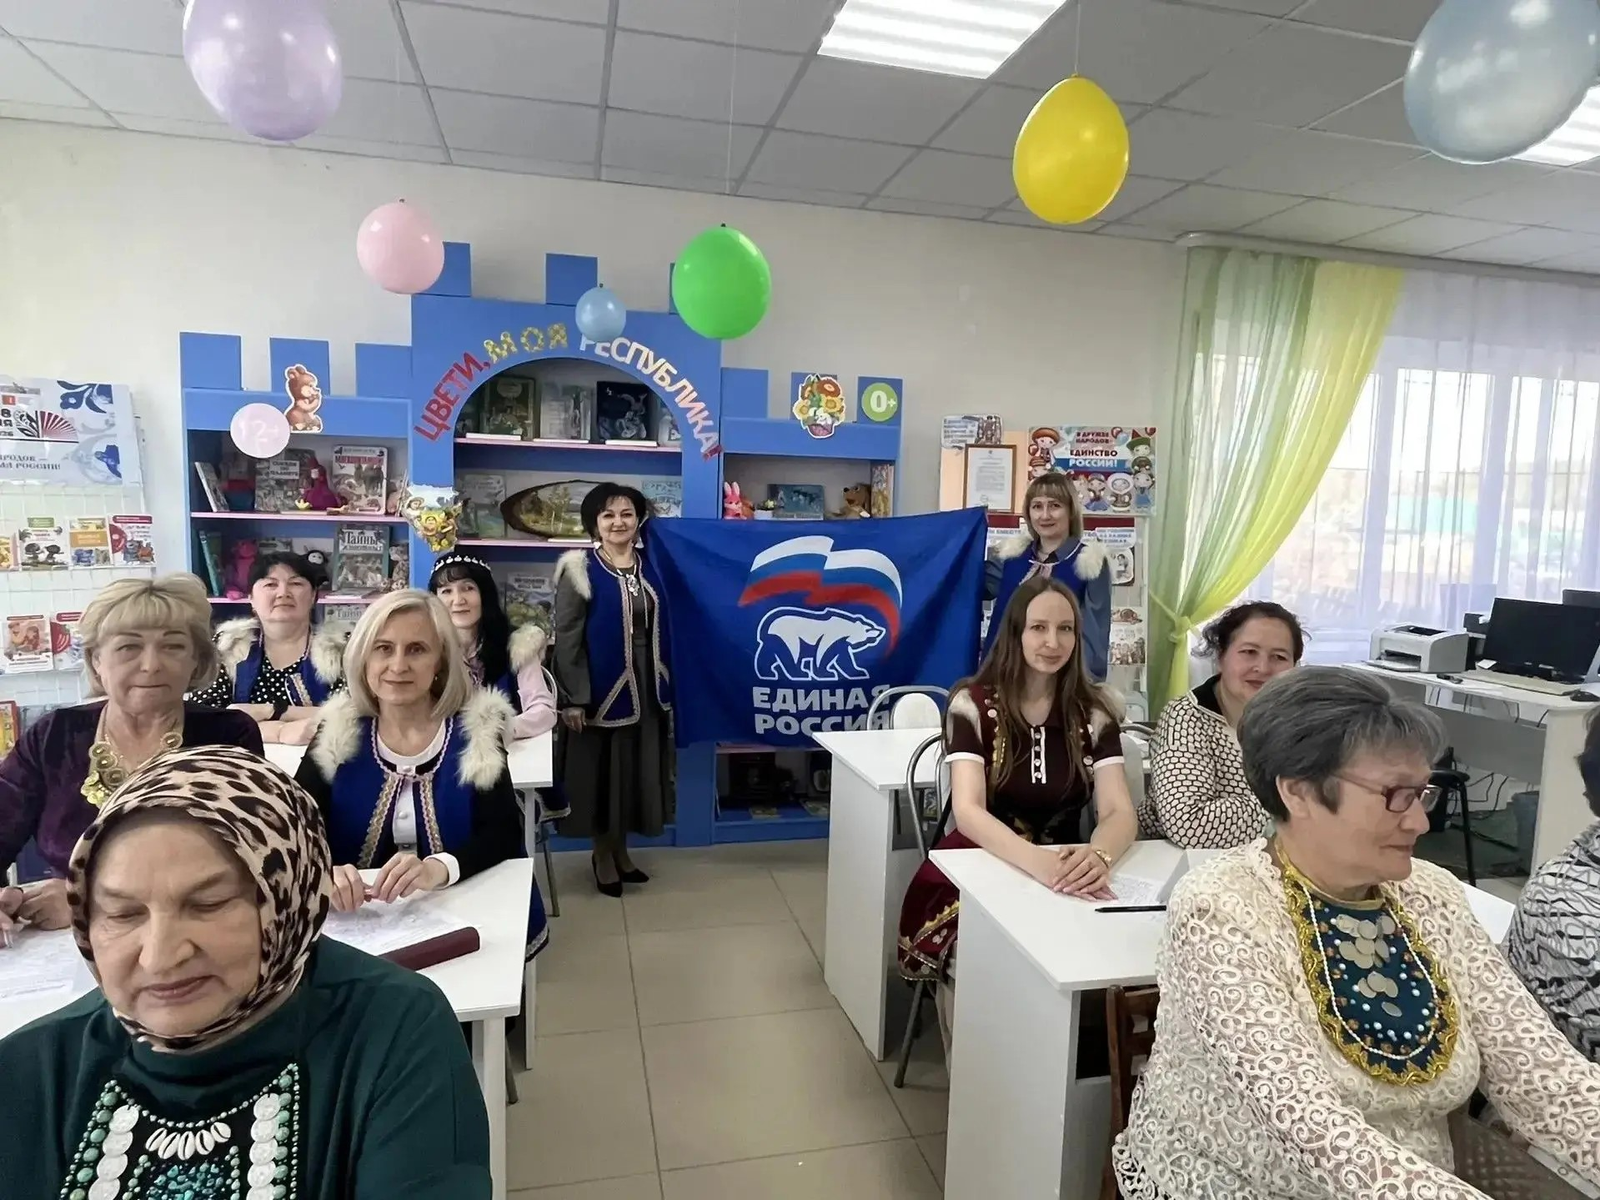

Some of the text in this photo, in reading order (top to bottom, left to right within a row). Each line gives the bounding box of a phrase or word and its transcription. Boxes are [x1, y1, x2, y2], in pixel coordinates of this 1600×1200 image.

[414, 352, 491, 442] ЦВЕТИ,
[483, 322, 568, 364] МОЯ
[870, 390, 896, 413] 0+
[239, 420, 279, 443] 12+
[1069, 449, 1118, 457] ЕДИНСТВО
[1069, 458, 1118, 468] РОССИИ!
[752, 684, 890, 714] ЕДИНАЯ
[754, 710, 890, 737] РОССИЯ
